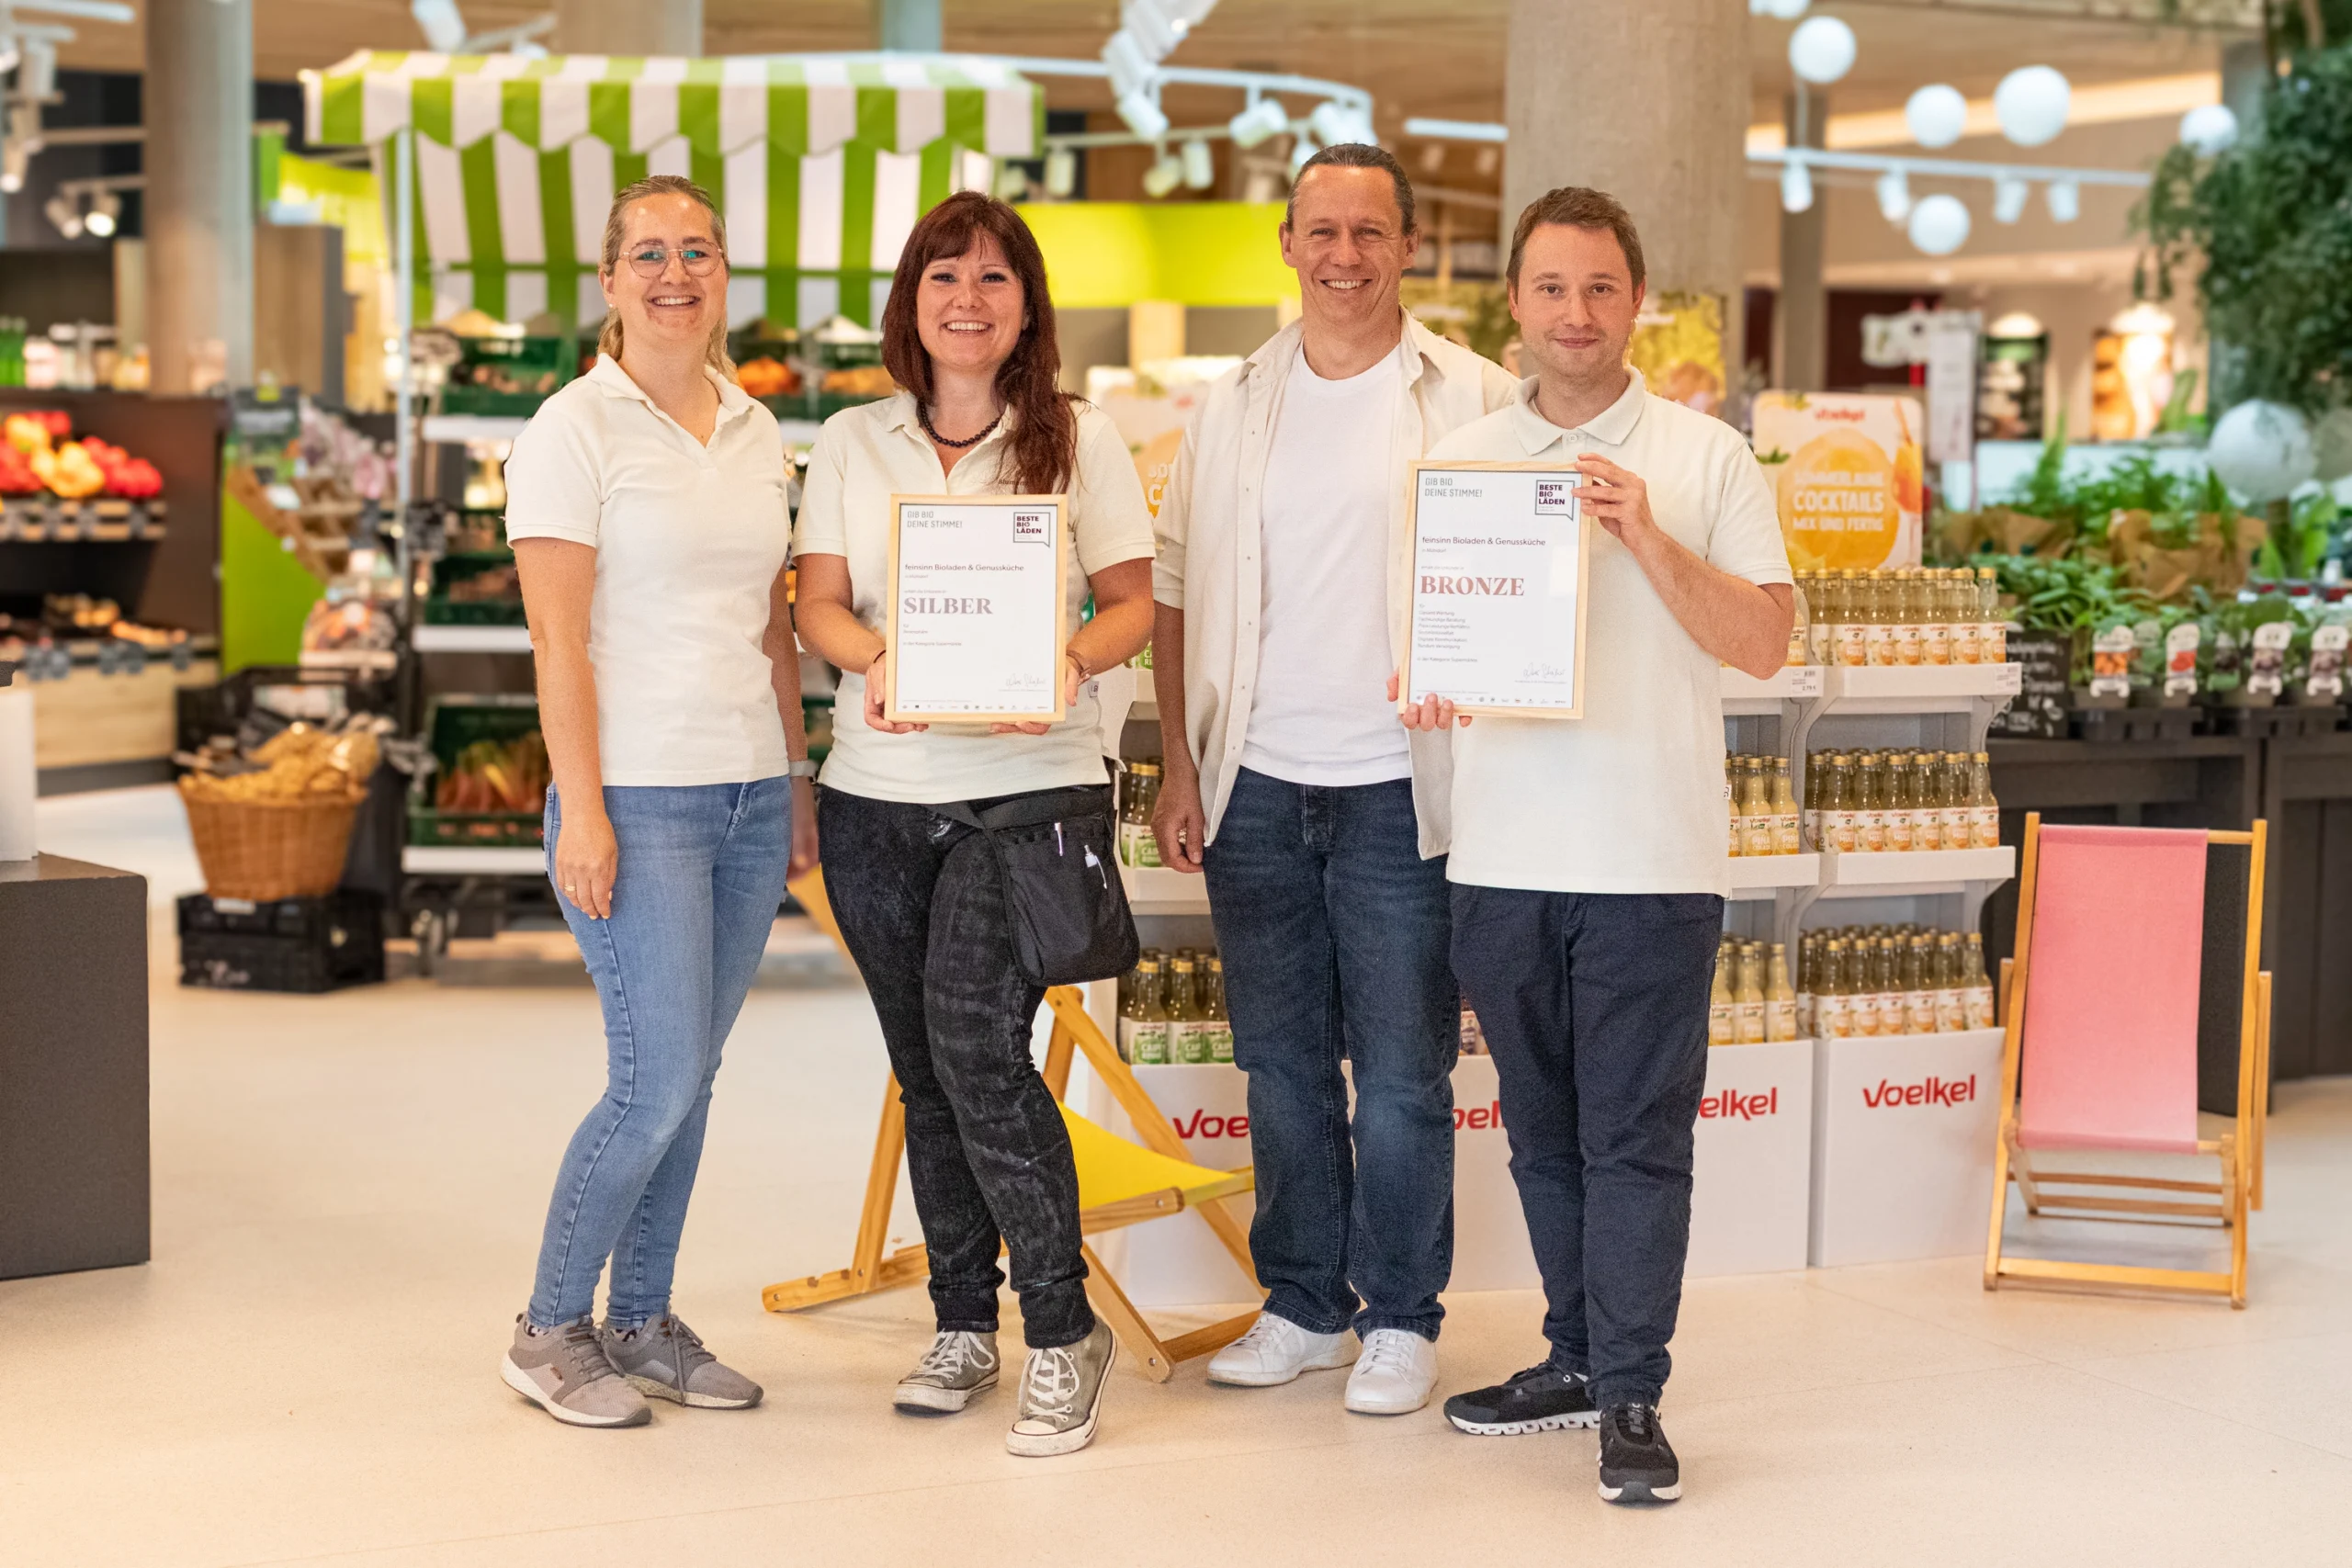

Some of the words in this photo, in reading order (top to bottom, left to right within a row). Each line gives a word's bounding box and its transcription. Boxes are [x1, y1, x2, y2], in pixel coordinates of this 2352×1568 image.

[1425, 477, 1439, 486] GIB
[1440, 478, 1453, 486] BIO
[1424, 489, 1447, 497] DEINE
[1449, 489, 1482, 498] STIMME!
[1538, 497, 1566, 505] LÄDEN
[1794, 490, 1884, 513] COCKTAILS
[907, 520, 929, 528] DEINE
[931, 520, 963, 528] STIMME!
[1453, 536, 1486, 545] Bioladen
[1495, 537, 1546, 547] Genussküche
[934, 563, 967, 571] Bioladen
[975, 564, 1024, 572] Genussküche
[1420, 575, 1525, 596] BRONZE
[904, 596, 993, 615] SILBER
[1862, 1074, 1975, 1108] Voelkel
[1172, 1108, 1250, 1140] Voe
